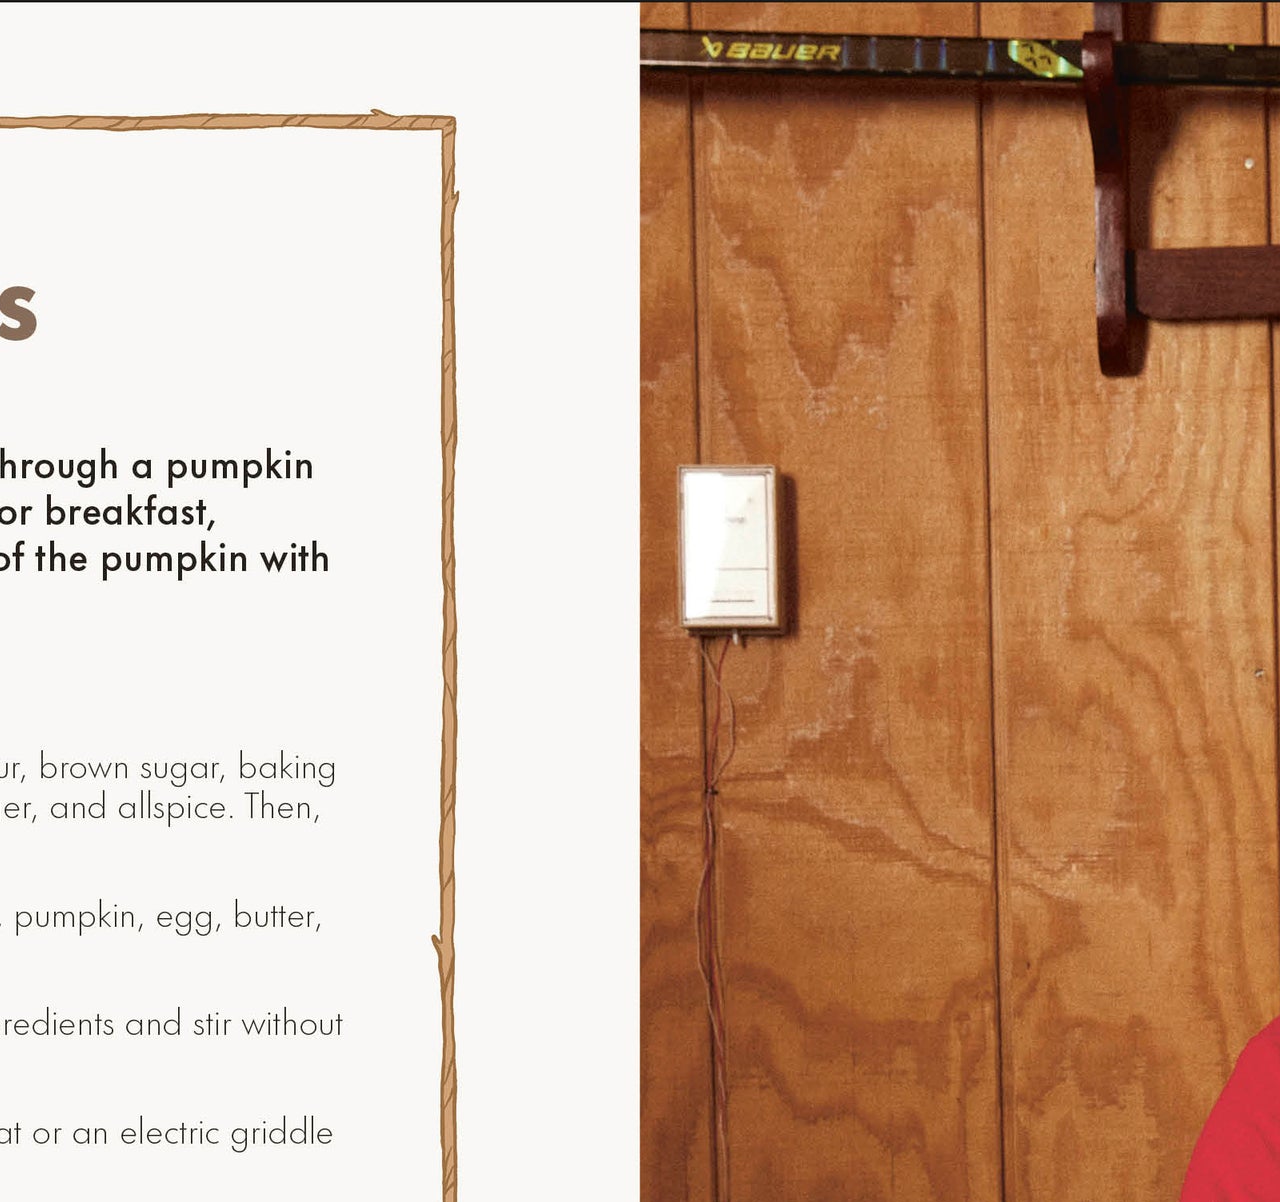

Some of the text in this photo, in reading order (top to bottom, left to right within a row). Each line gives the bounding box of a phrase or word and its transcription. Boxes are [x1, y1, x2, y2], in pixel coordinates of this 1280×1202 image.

[725, 41, 841, 61] BAUER
[131, 459, 152, 480] a
[167, 447, 313, 489] pumpkin
[46, 493, 216, 532] breakfast,
[40, 749, 128, 780] brown
[140, 762, 225, 788] sugar,
[239, 749, 335, 788] baking
[50, 789, 106, 819] and
[118, 789, 234, 828] allspice.
[243, 789, 320, 824] Then,
[125, 1006, 181, 1036] and
[193, 1011, 233, 1036] stir
[241, 1006, 344, 1036] without
